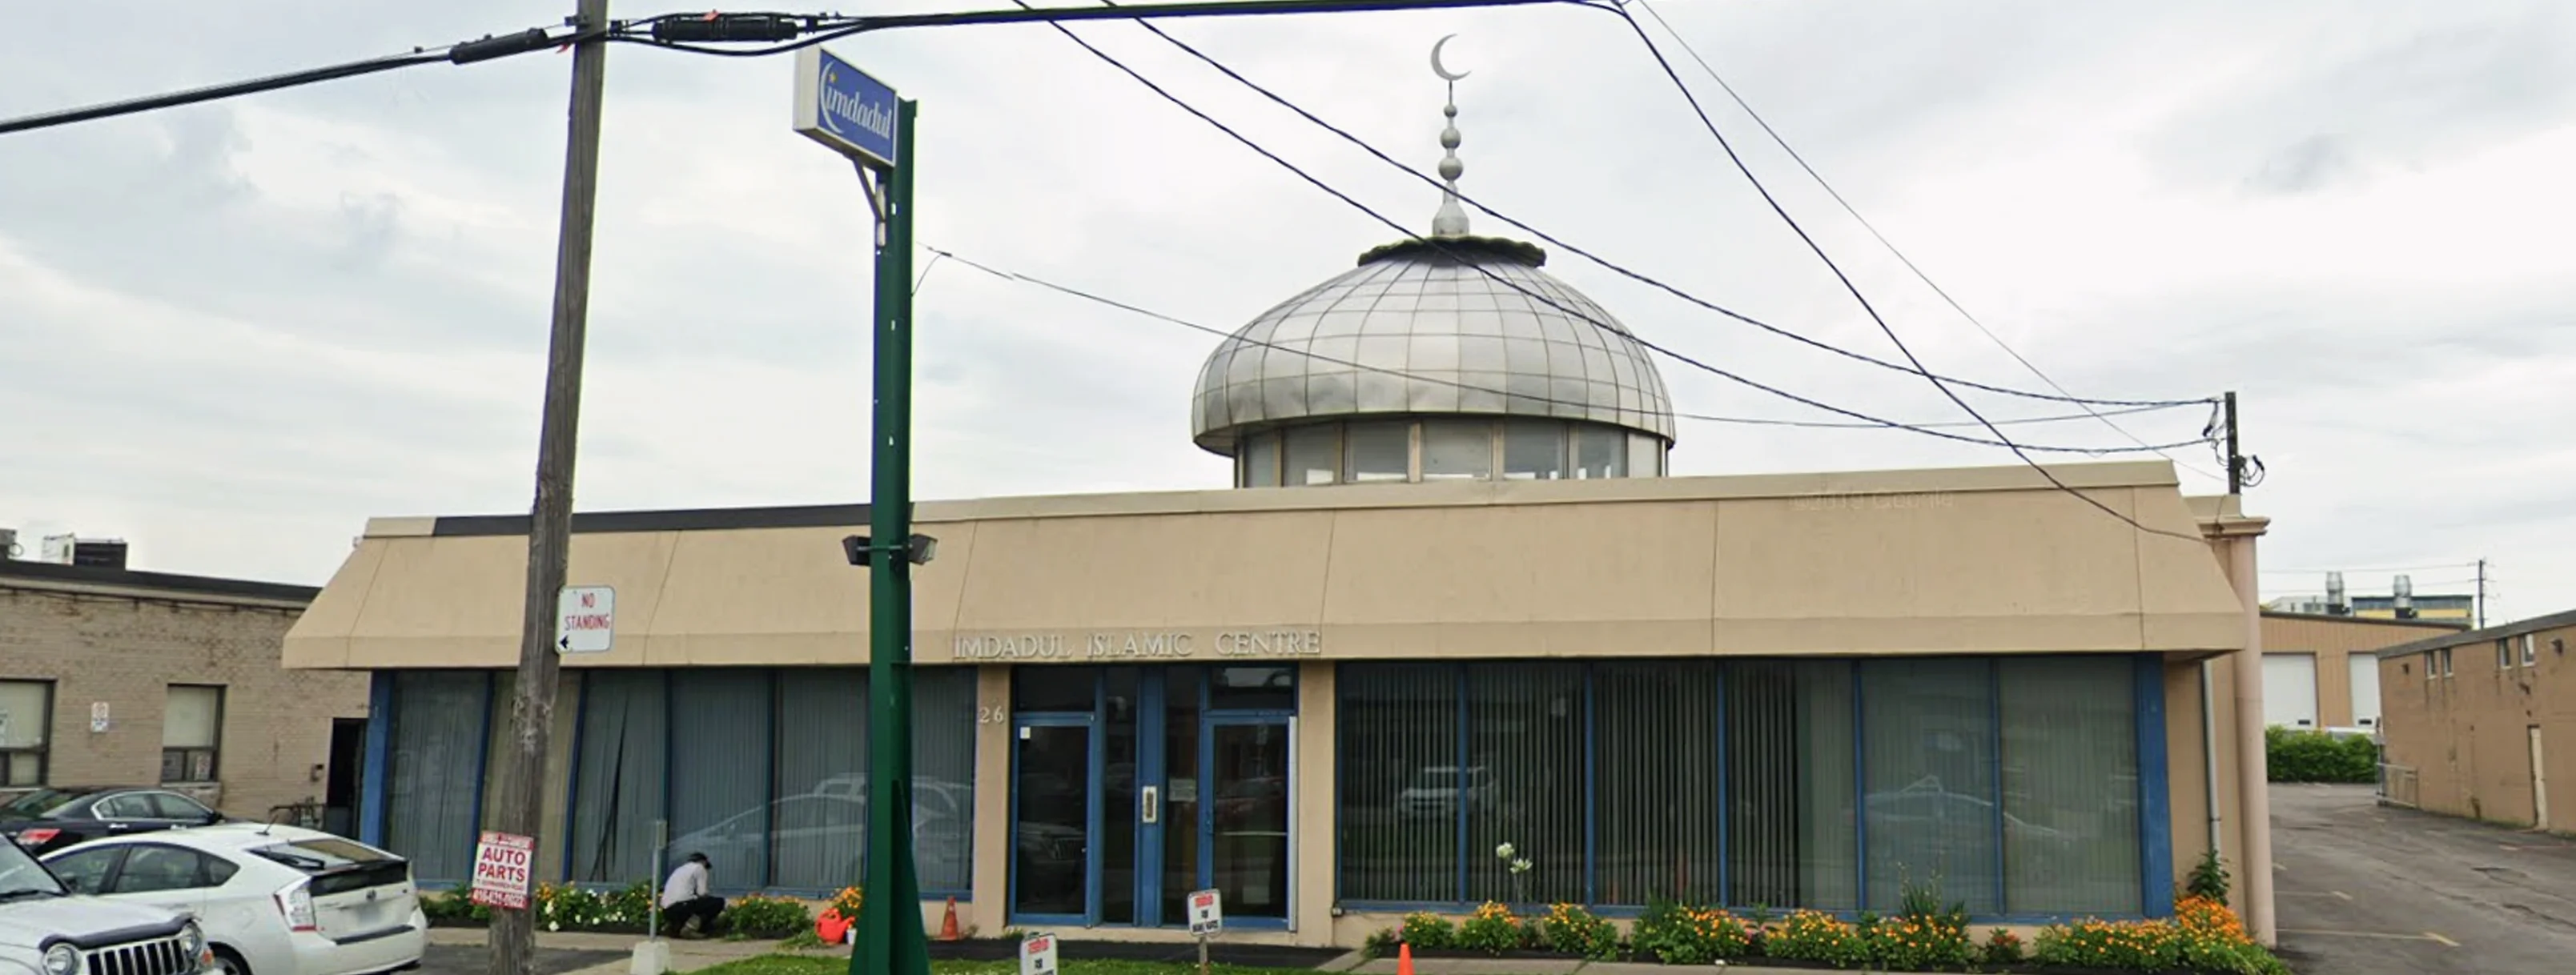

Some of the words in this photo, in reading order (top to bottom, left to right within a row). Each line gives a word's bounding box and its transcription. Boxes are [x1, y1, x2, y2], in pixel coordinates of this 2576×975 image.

[826, 84, 892, 139] imdadul
[581, 592, 596, 608] NO
[564, 614, 609, 632] STANDING
[954, 634, 1074, 659] IMDADUL
[1087, 631, 1193, 657] ISLAMIC
[1215, 629, 1321, 656] CENTRE
[979, 705, 1004, 724] 26
[482, 847, 526, 865] AUTO
[477, 862, 526, 882] PARTS
